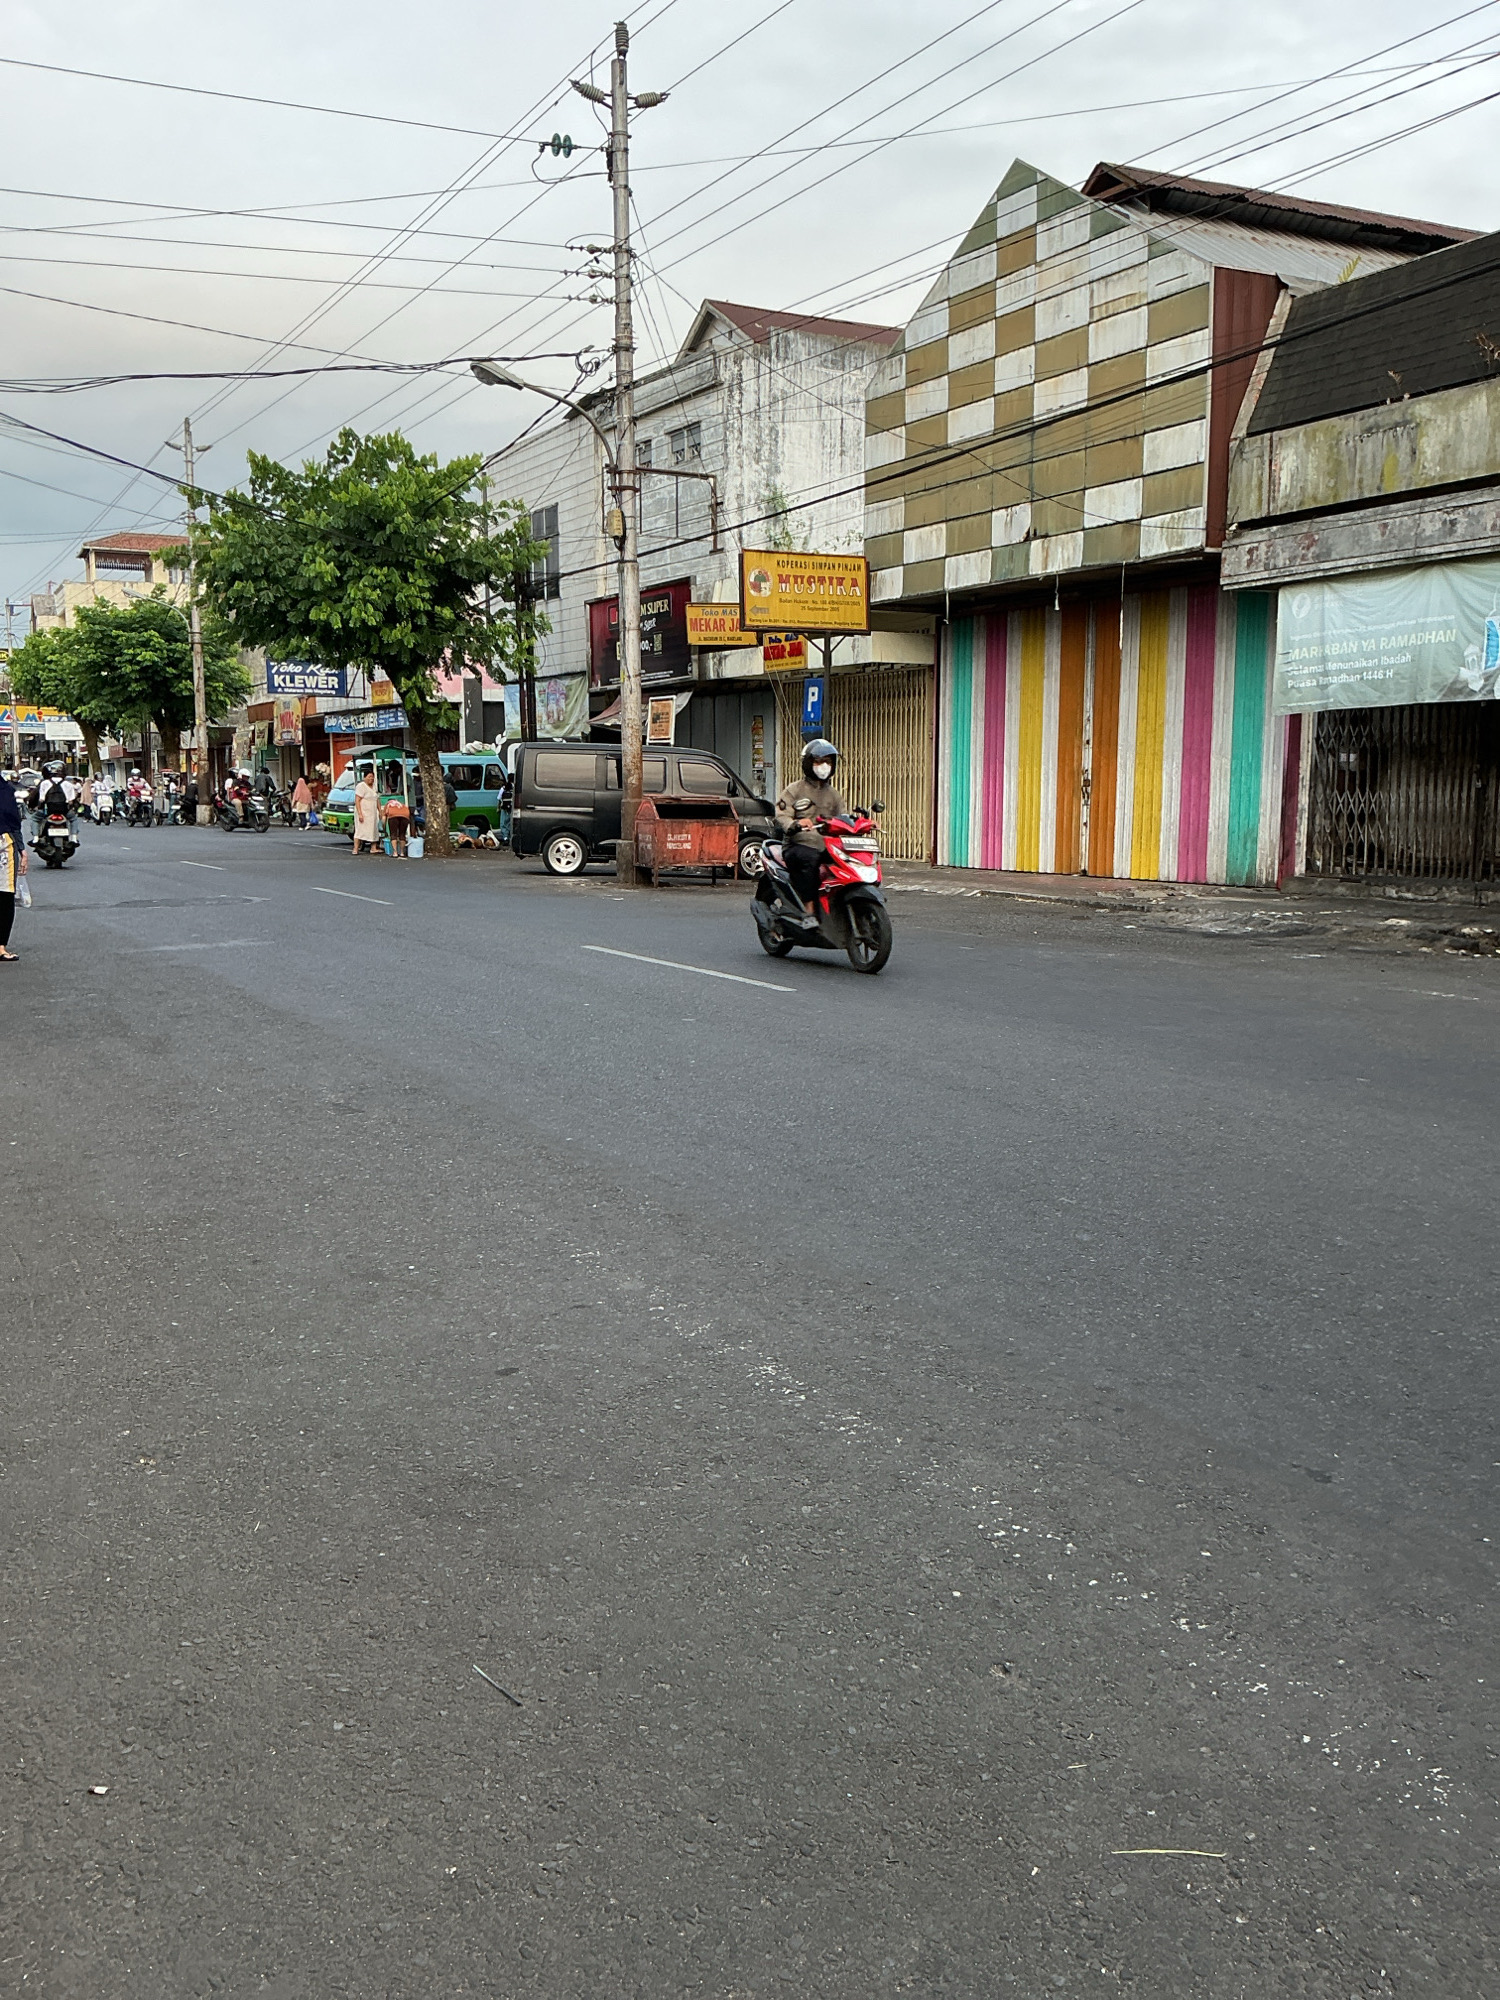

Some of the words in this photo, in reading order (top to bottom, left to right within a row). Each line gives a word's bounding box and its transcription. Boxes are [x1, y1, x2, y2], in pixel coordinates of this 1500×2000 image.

[777, 559, 810, 569] KOPERASI
[812, 561, 836, 570] SIMPAN
[837, 562, 862, 572] PINJAM
[777, 573, 862, 597] MUSTIKA
[701, 608, 719, 617] Toko
[720, 608, 738, 617] MAS
[689, 617, 726, 632] MEKAR
[1362, 640, 1376, 652] YA
[1380, 629, 1457, 651] RAMADHAN
[1380, 652, 1412, 666] Ibadah
[270, 662, 303, 674] Toko
[1362, 669, 1384, 681] 1446
[1386, 669, 1393, 679] H
[274, 675, 339, 688] KLEWER
[807, 686, 819, 711] P
[350, 711, 378, 730] KLEWER
